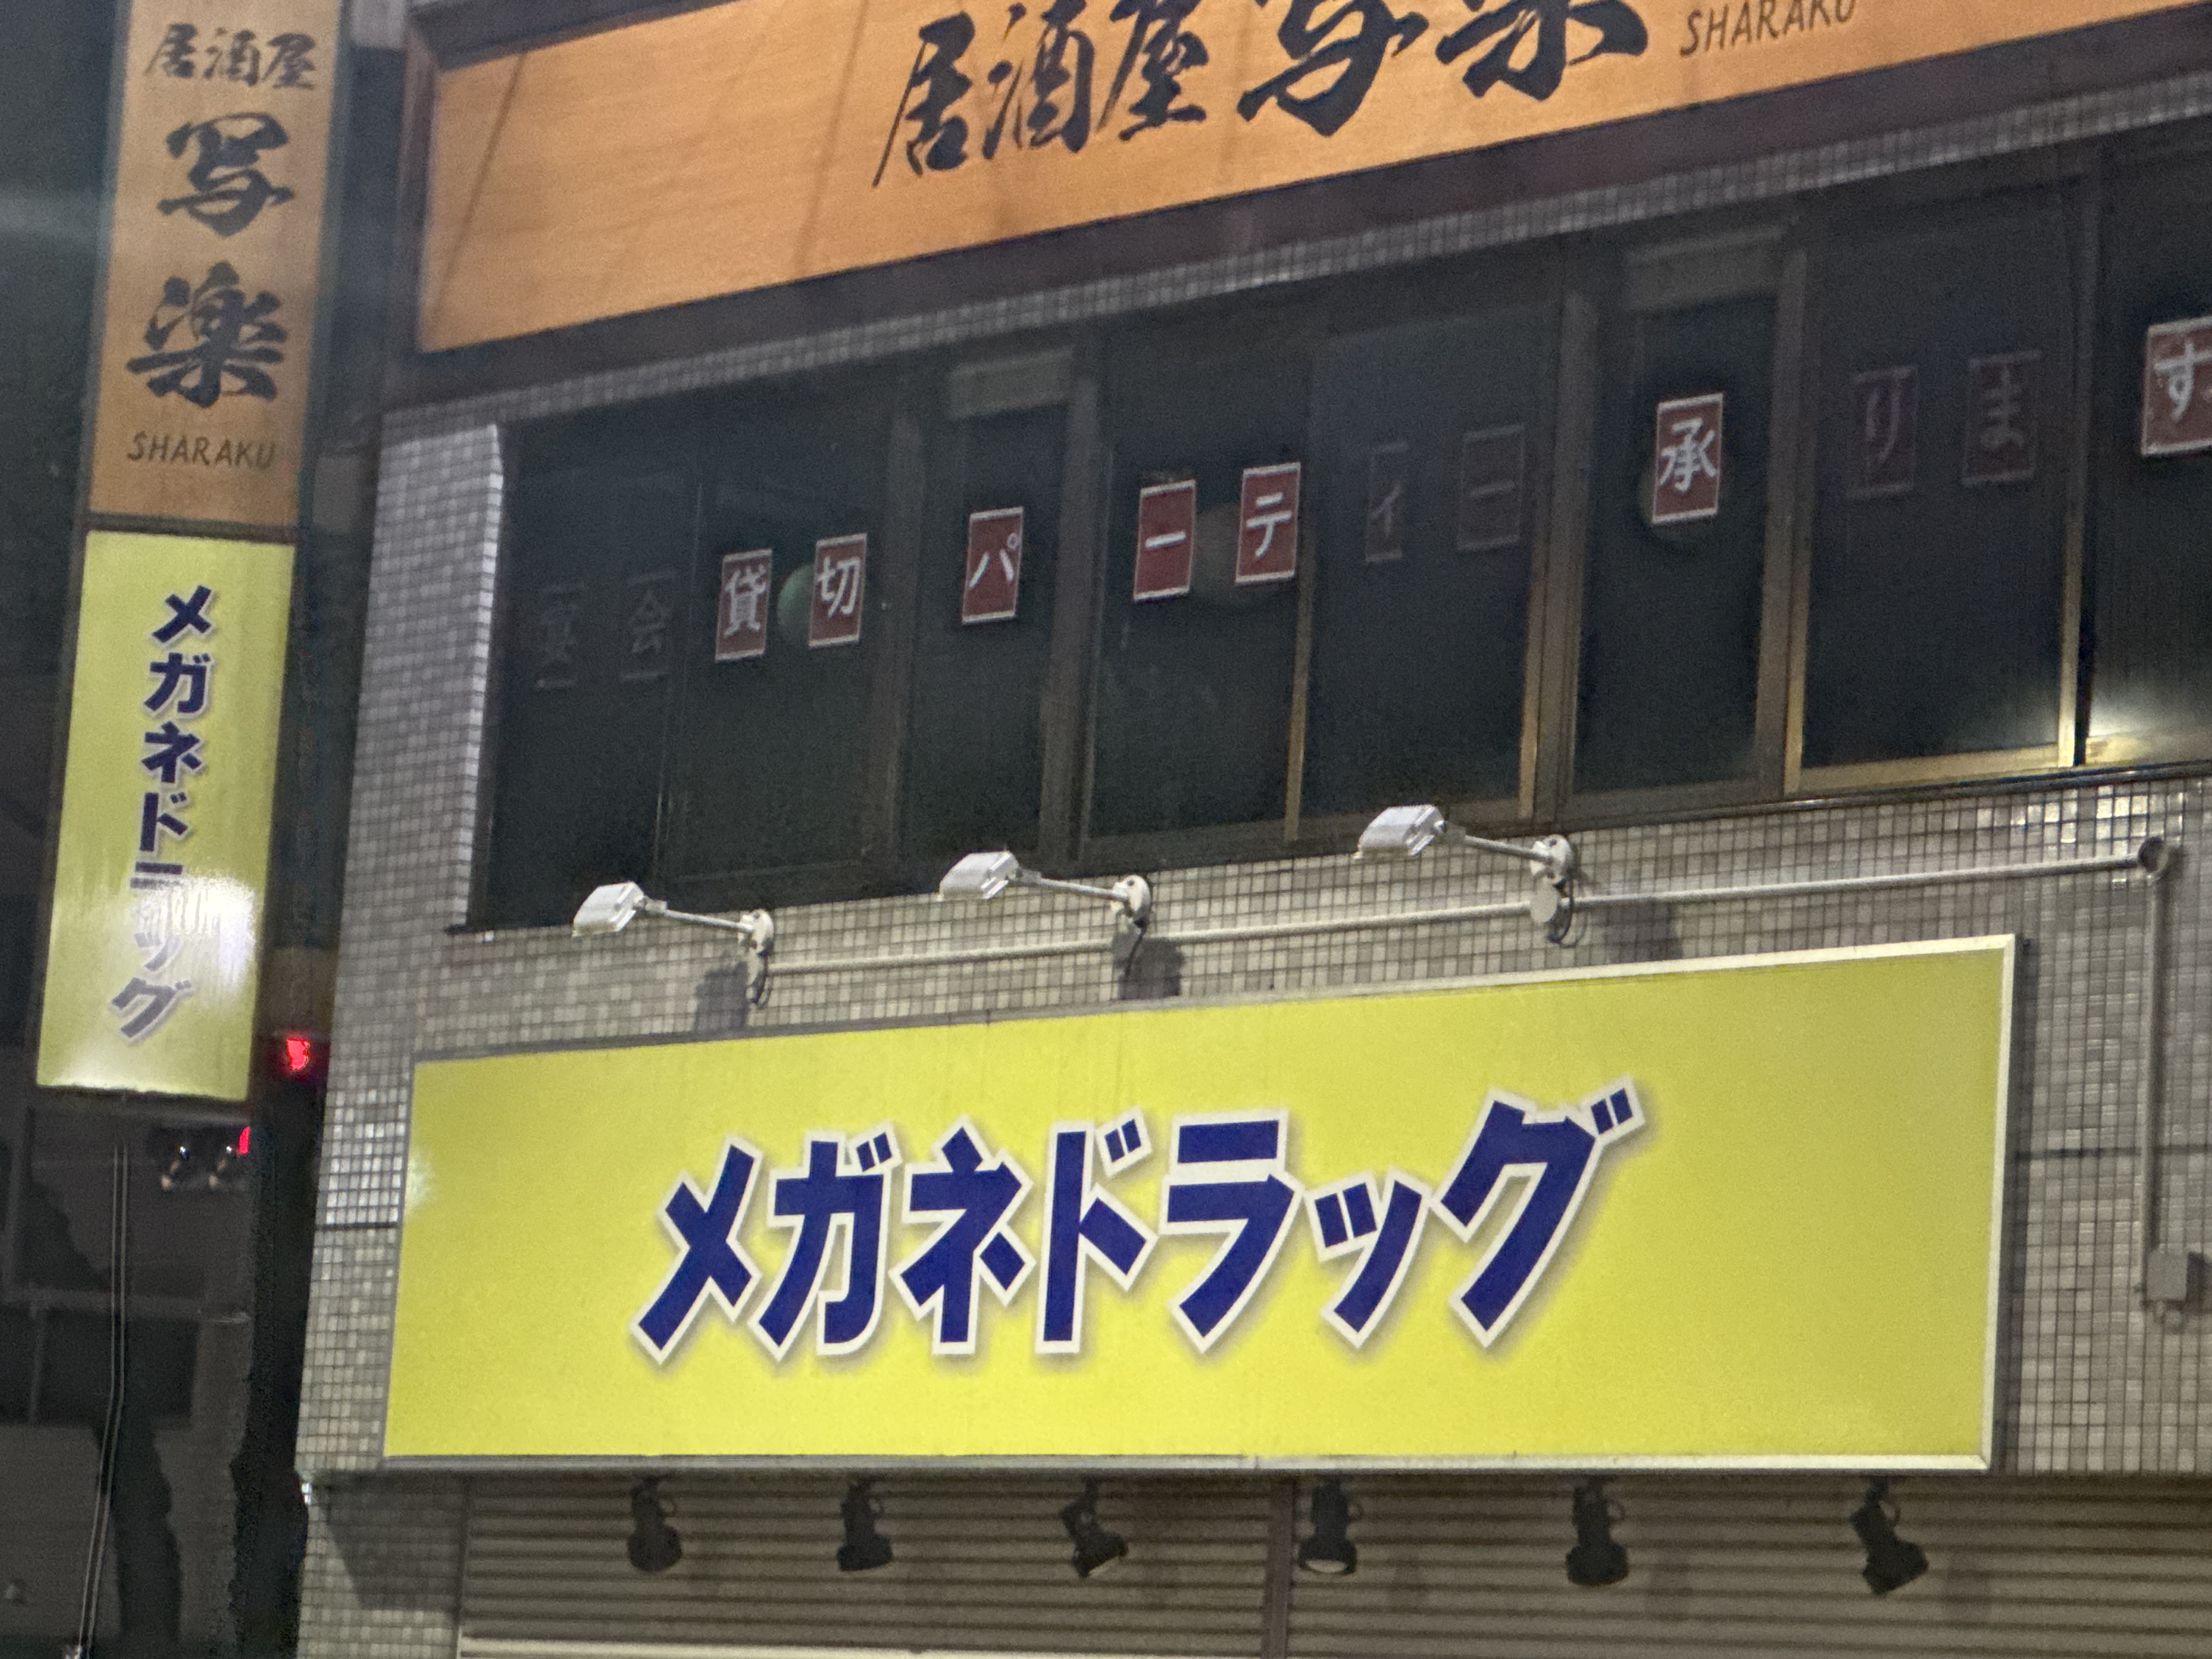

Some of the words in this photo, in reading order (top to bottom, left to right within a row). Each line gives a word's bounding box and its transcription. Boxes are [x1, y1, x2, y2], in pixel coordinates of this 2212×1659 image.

[144, 22, 317, 90] 居酒屋
[1680, 0, 1856, 55] SHARAKU
[126, 112, 294, 407] 写楽
[128, 431, 276, 469] SHARAKU
[634, 1081, 1640, 1356] メガネドラッグ
